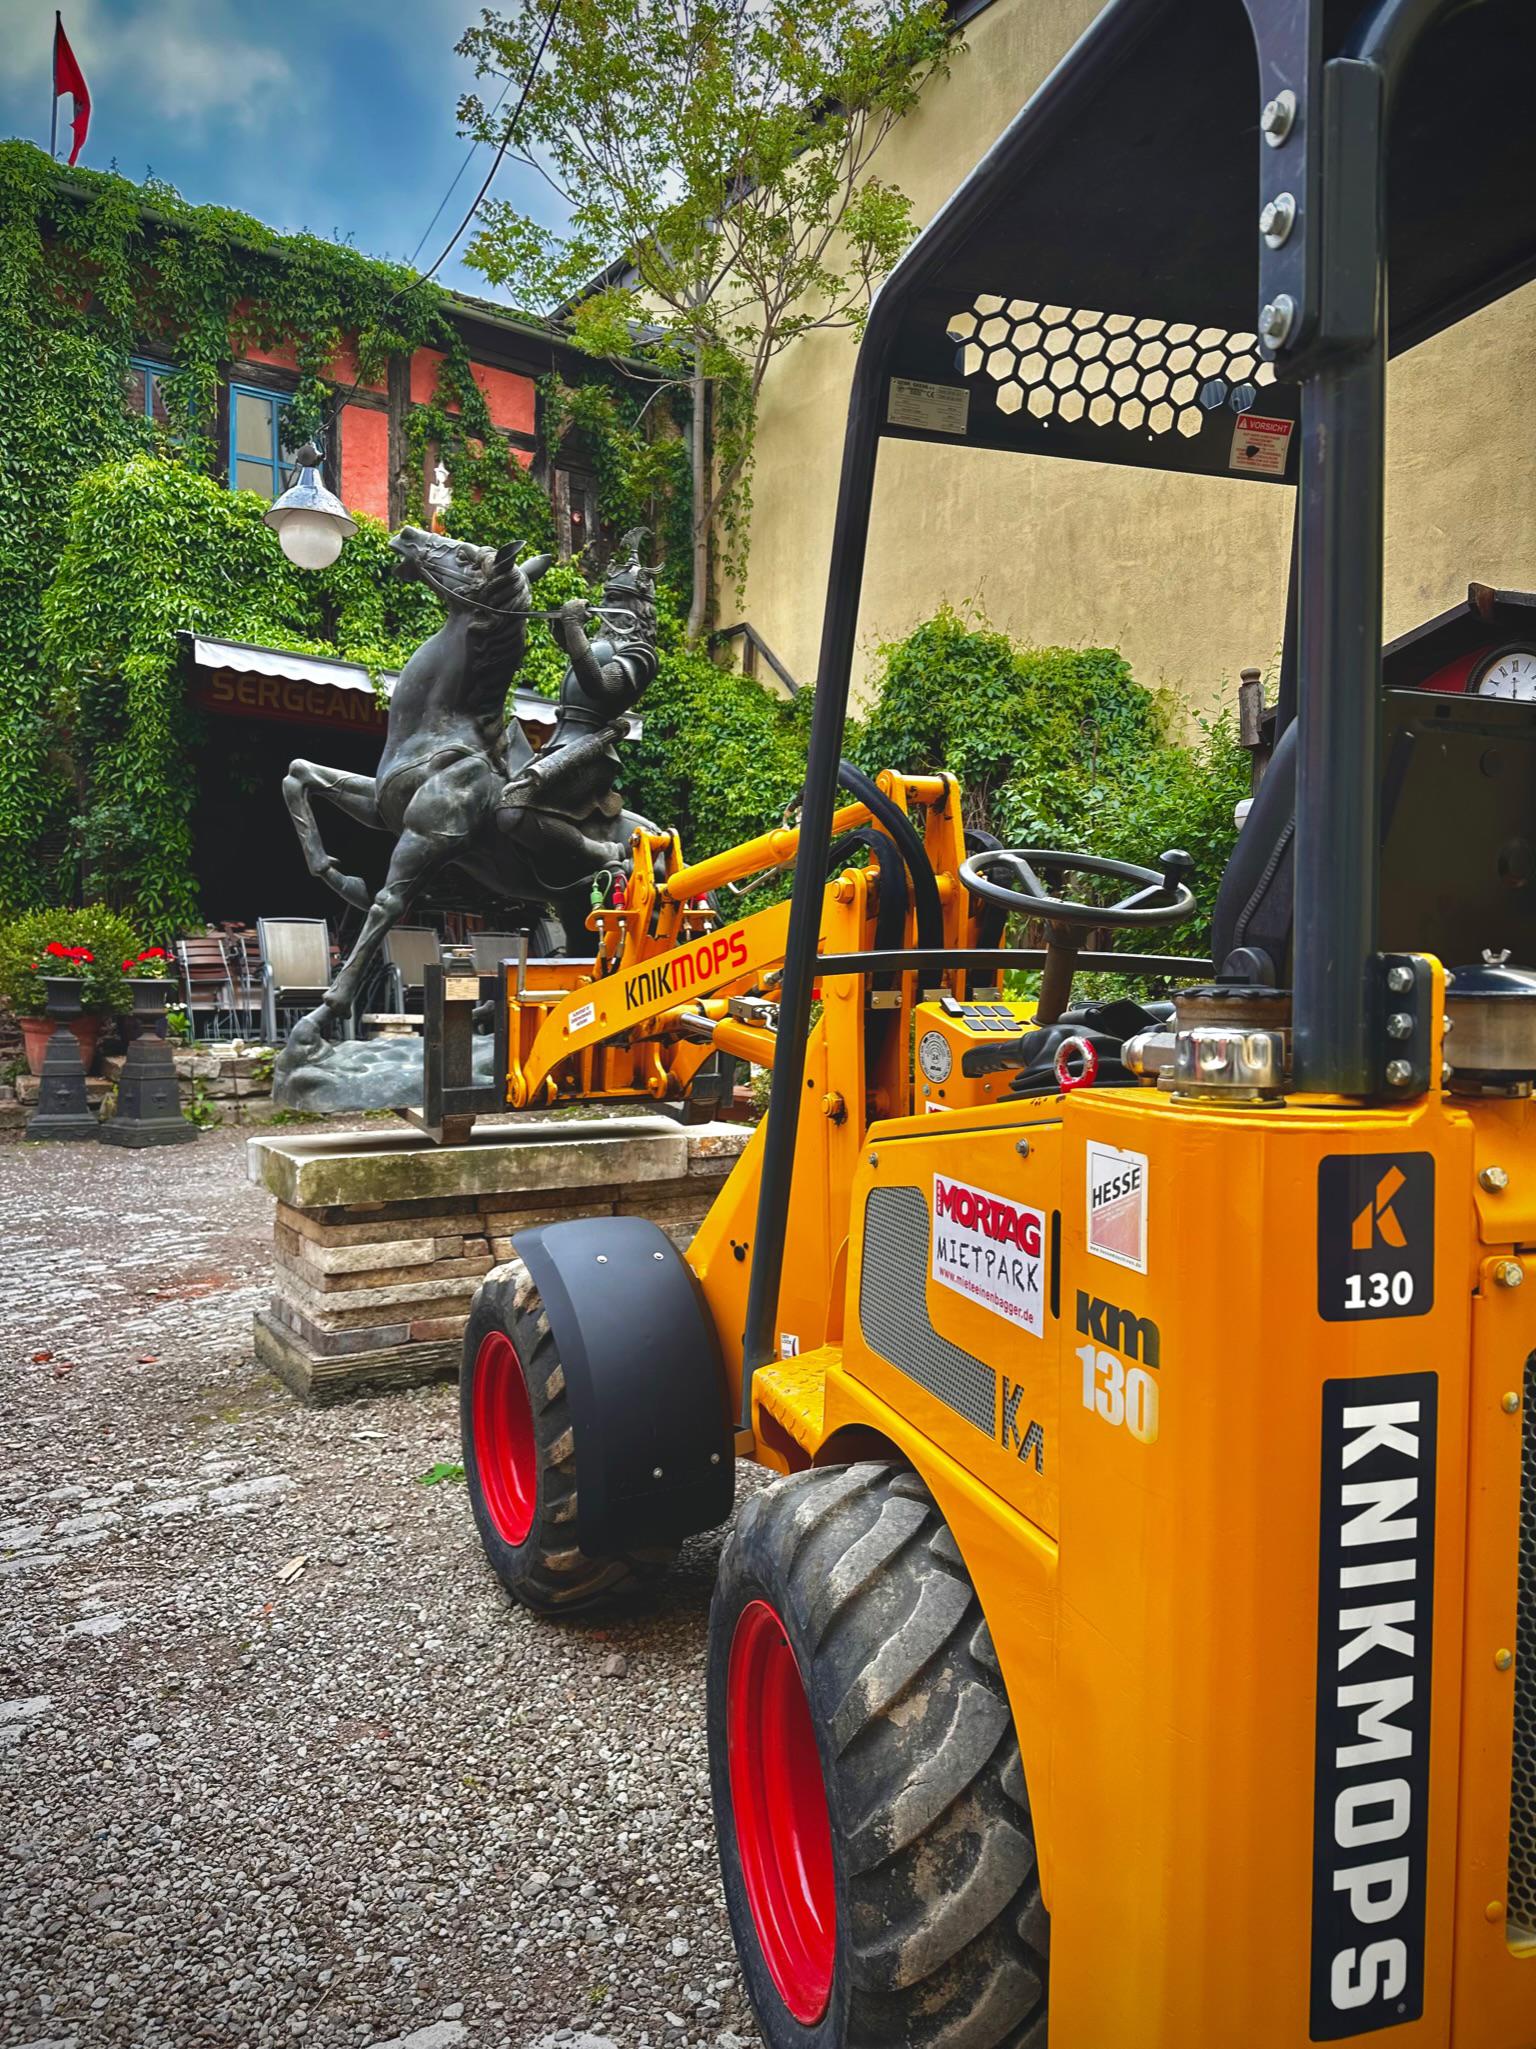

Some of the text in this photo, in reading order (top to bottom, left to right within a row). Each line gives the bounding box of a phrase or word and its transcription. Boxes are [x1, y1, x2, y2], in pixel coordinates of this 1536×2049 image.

[1249, 421, 1289, 433] VORSICHT
[625, 930, 748, 1011] KNIKMOPS
[1092, 1167, 1141, 1209] HESSE
[936, 1179, 1041, 1259] MORTAG
[936, 1236, 1040, 1293] MIETPARK
[1344, 1270, 1414, 1310] 130
[938, 1266, 1034, 1324] www.mieteeinenbagger.de
[1075, 1343, 1160, 1445] 130
[1331, 1400, 1421, 2011] KNIKMOPS
